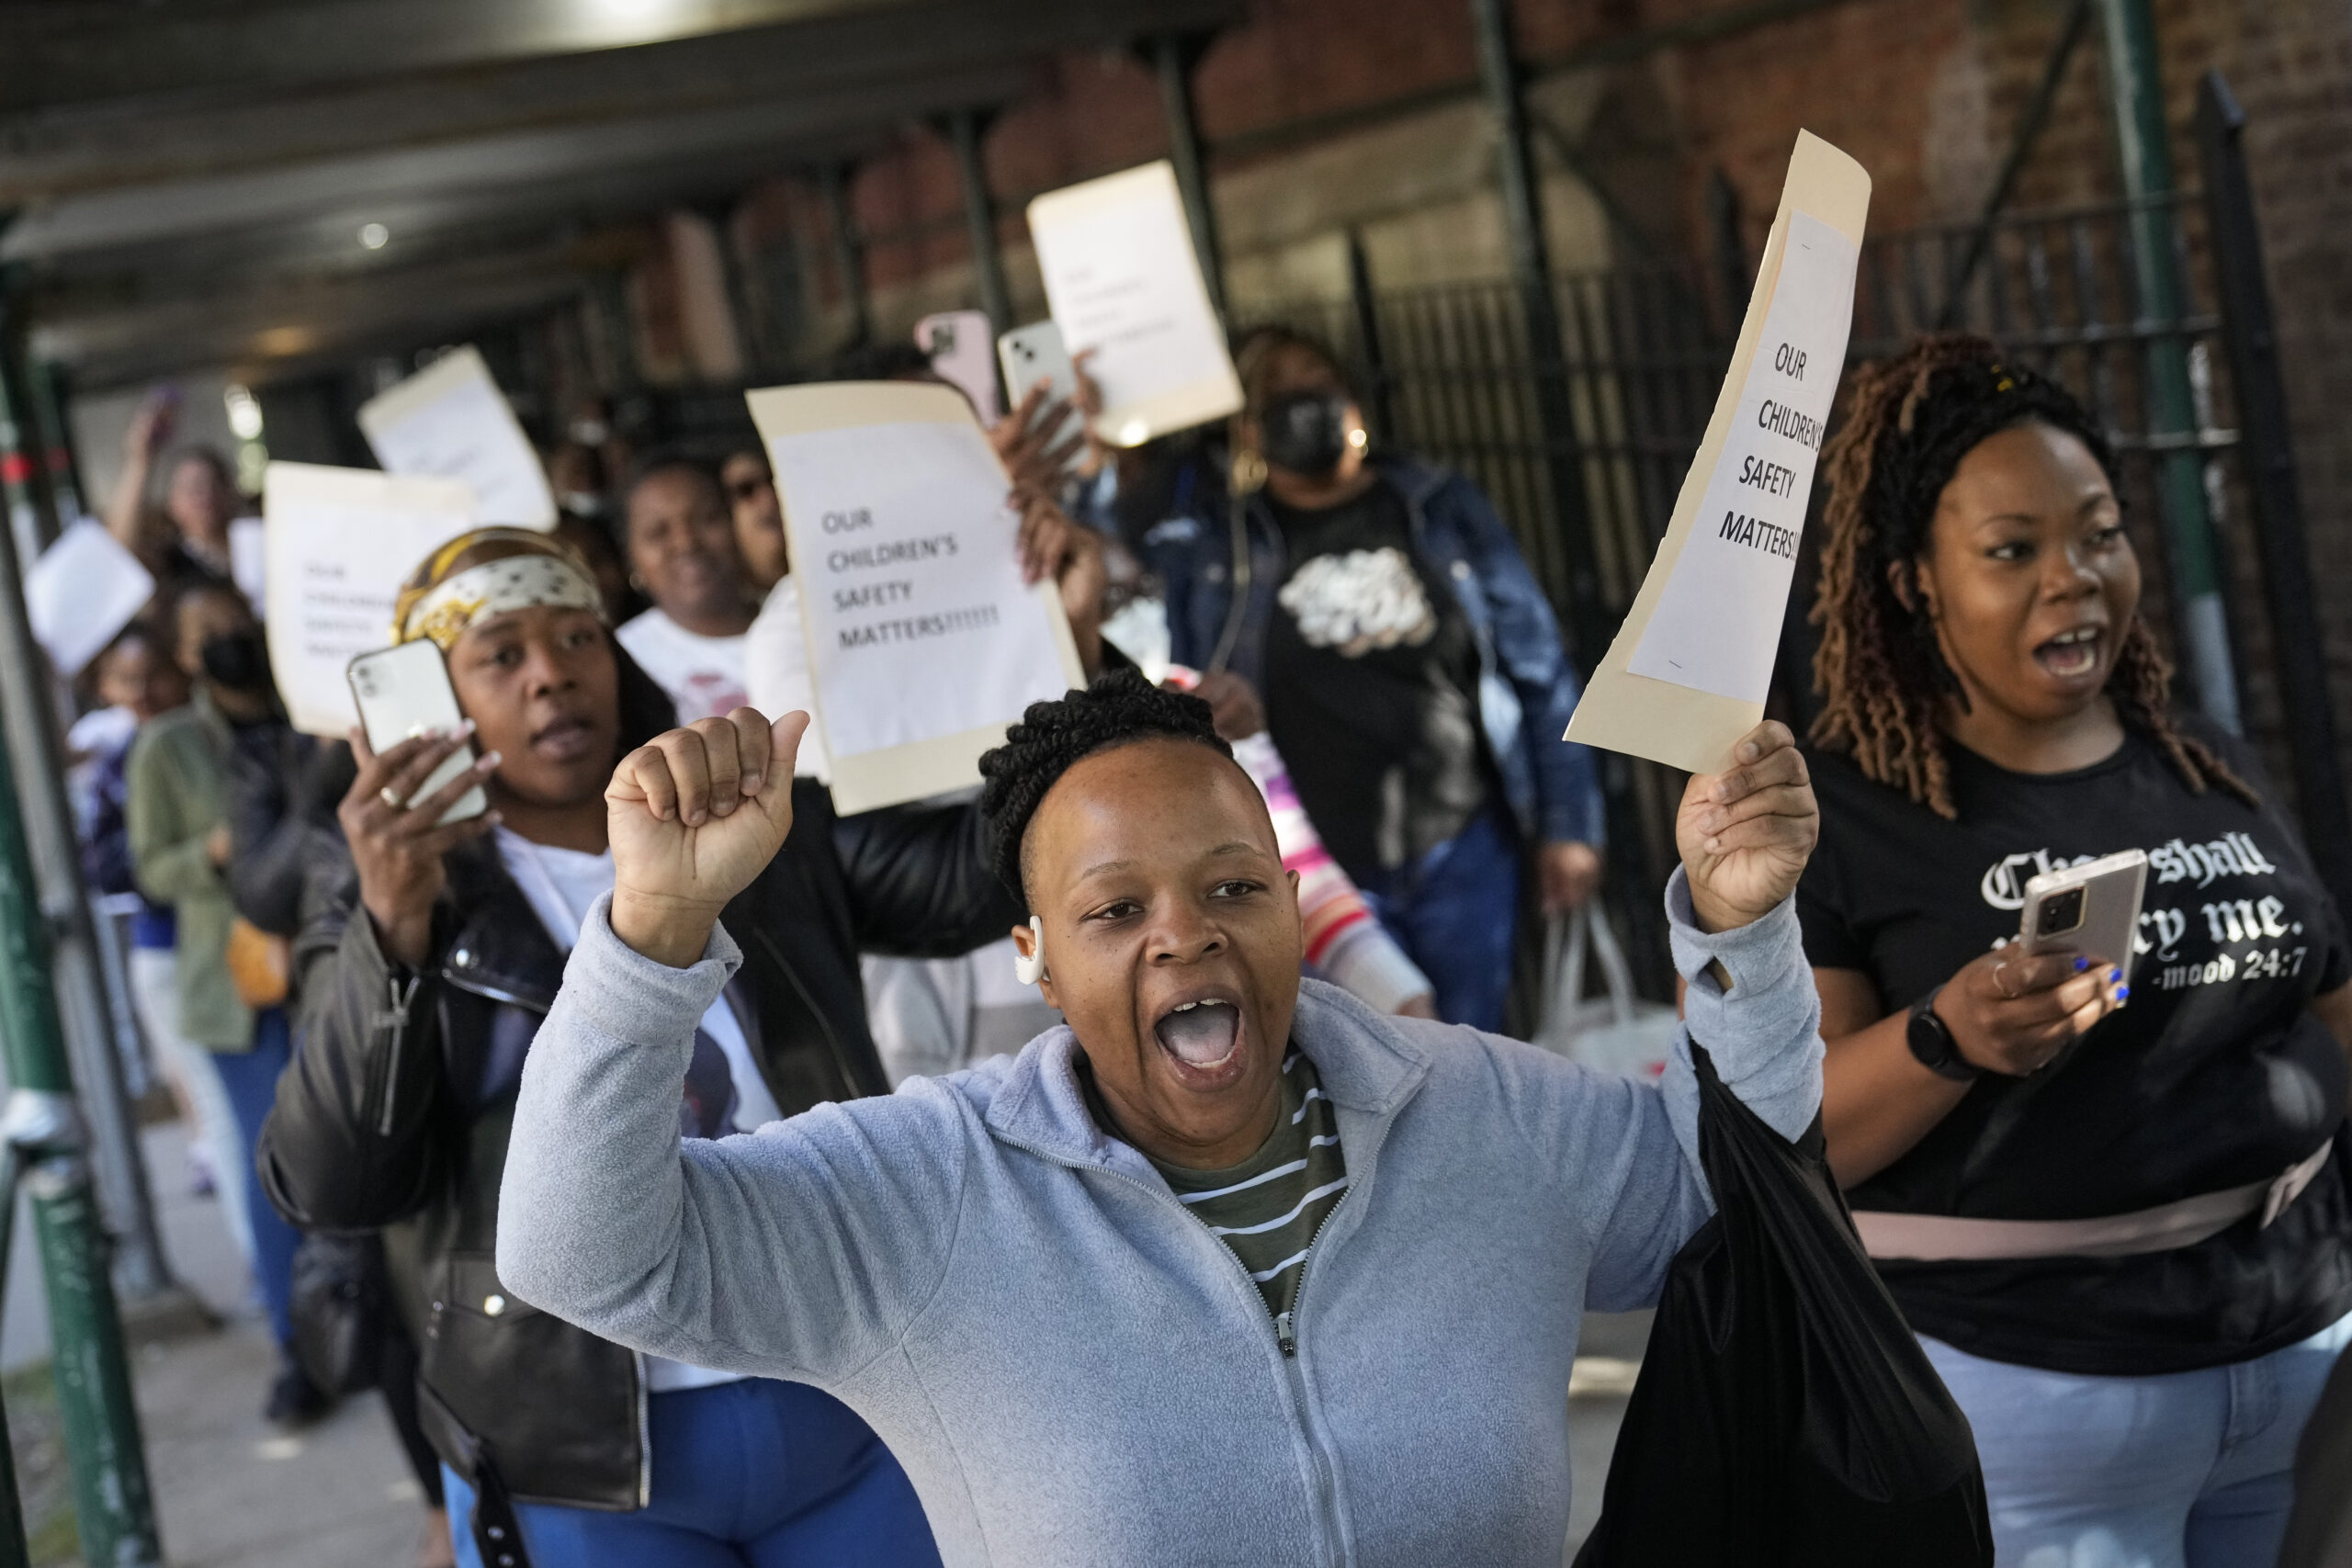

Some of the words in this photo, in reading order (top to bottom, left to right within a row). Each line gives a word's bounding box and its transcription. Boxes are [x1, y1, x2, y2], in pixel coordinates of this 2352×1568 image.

[1775, 343, 1807, 381] OUR
[1738, 456, 1796, 499] SAFETY
[822, 508, 873, 535] OUR
[828, 533, 958, 572] CHILDREN'S
[832, 580, 911, 611] SAFETY
[2149, 830, 2276, 888] shall
[2200, 895, 2303, 943] me.
[2242, 947, 2308, 981] 24:7
